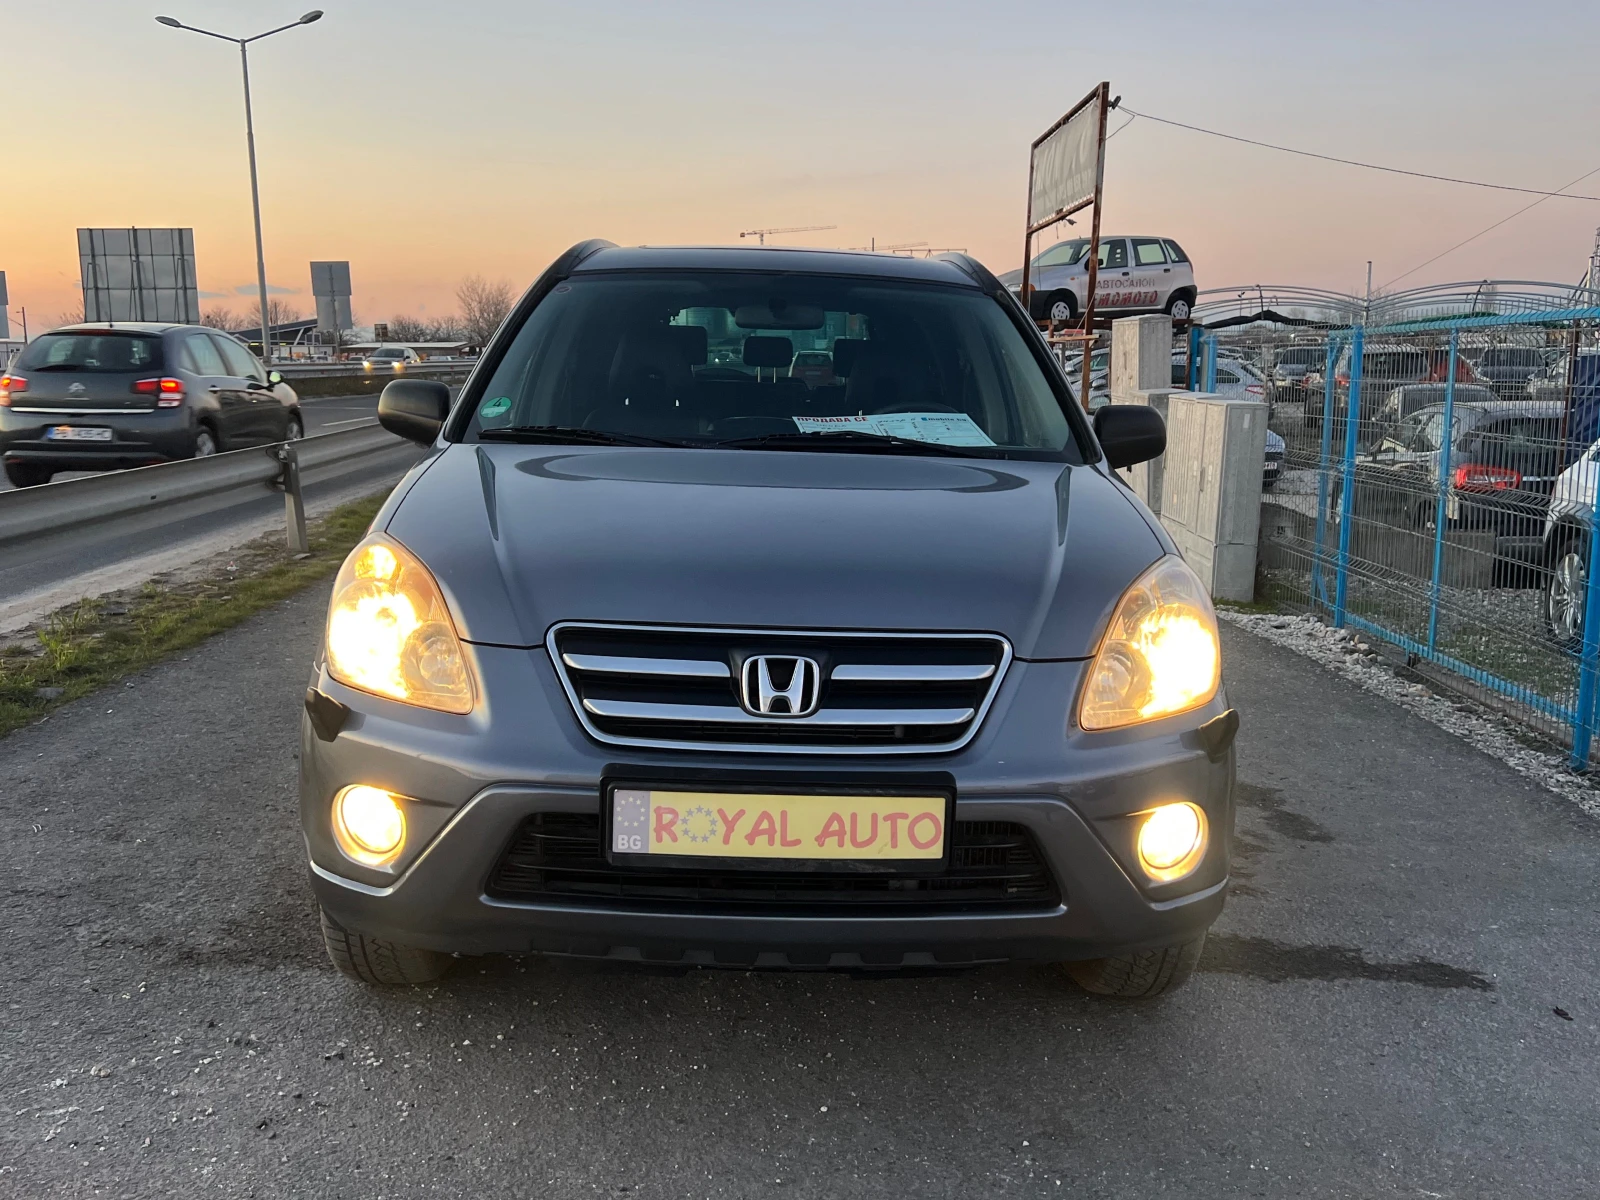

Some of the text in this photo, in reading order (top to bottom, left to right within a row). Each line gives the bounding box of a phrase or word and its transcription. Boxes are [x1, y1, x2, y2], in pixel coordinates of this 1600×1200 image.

[493, 397, 502, 407] 4
[653, 805, 942, 850] ROYAL AUTO
[617, 834, 642, 850] BG
